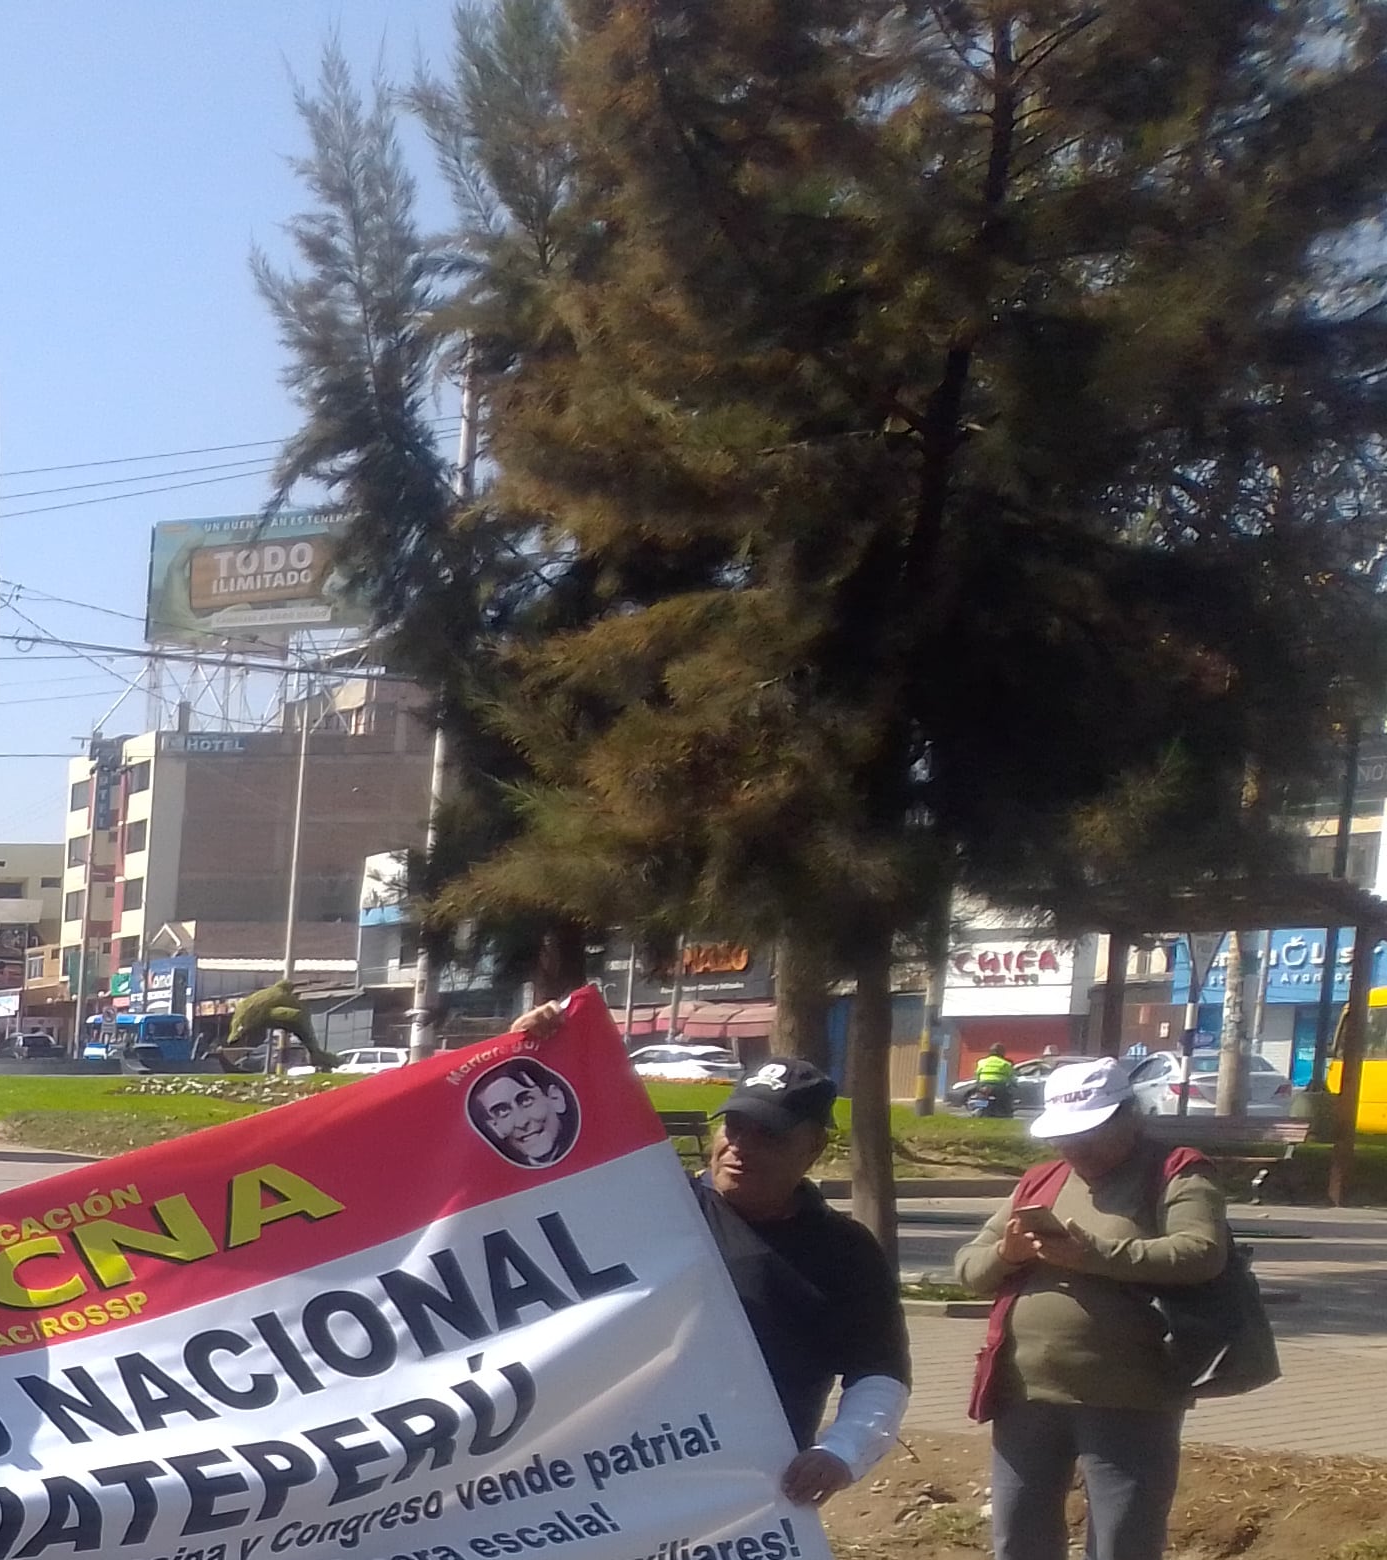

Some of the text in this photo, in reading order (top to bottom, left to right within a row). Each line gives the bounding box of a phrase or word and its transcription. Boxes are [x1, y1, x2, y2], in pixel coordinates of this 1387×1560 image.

[213, 541, 314, 577] TODO
[211, 570, 313, 594] ILIMITADO
[186, 739, 245, 751] HOTEL
[954, 949, 1060, 974] CHIFA
[15, 1210, 640, 1446] NACIONAL
[268, 1487, 444, 1556] Congreso
[454, 1451, 577, 1510] vende
[587, 1411, 725, 1494] patria!
[466, 1499, 623, 1560] escala!
